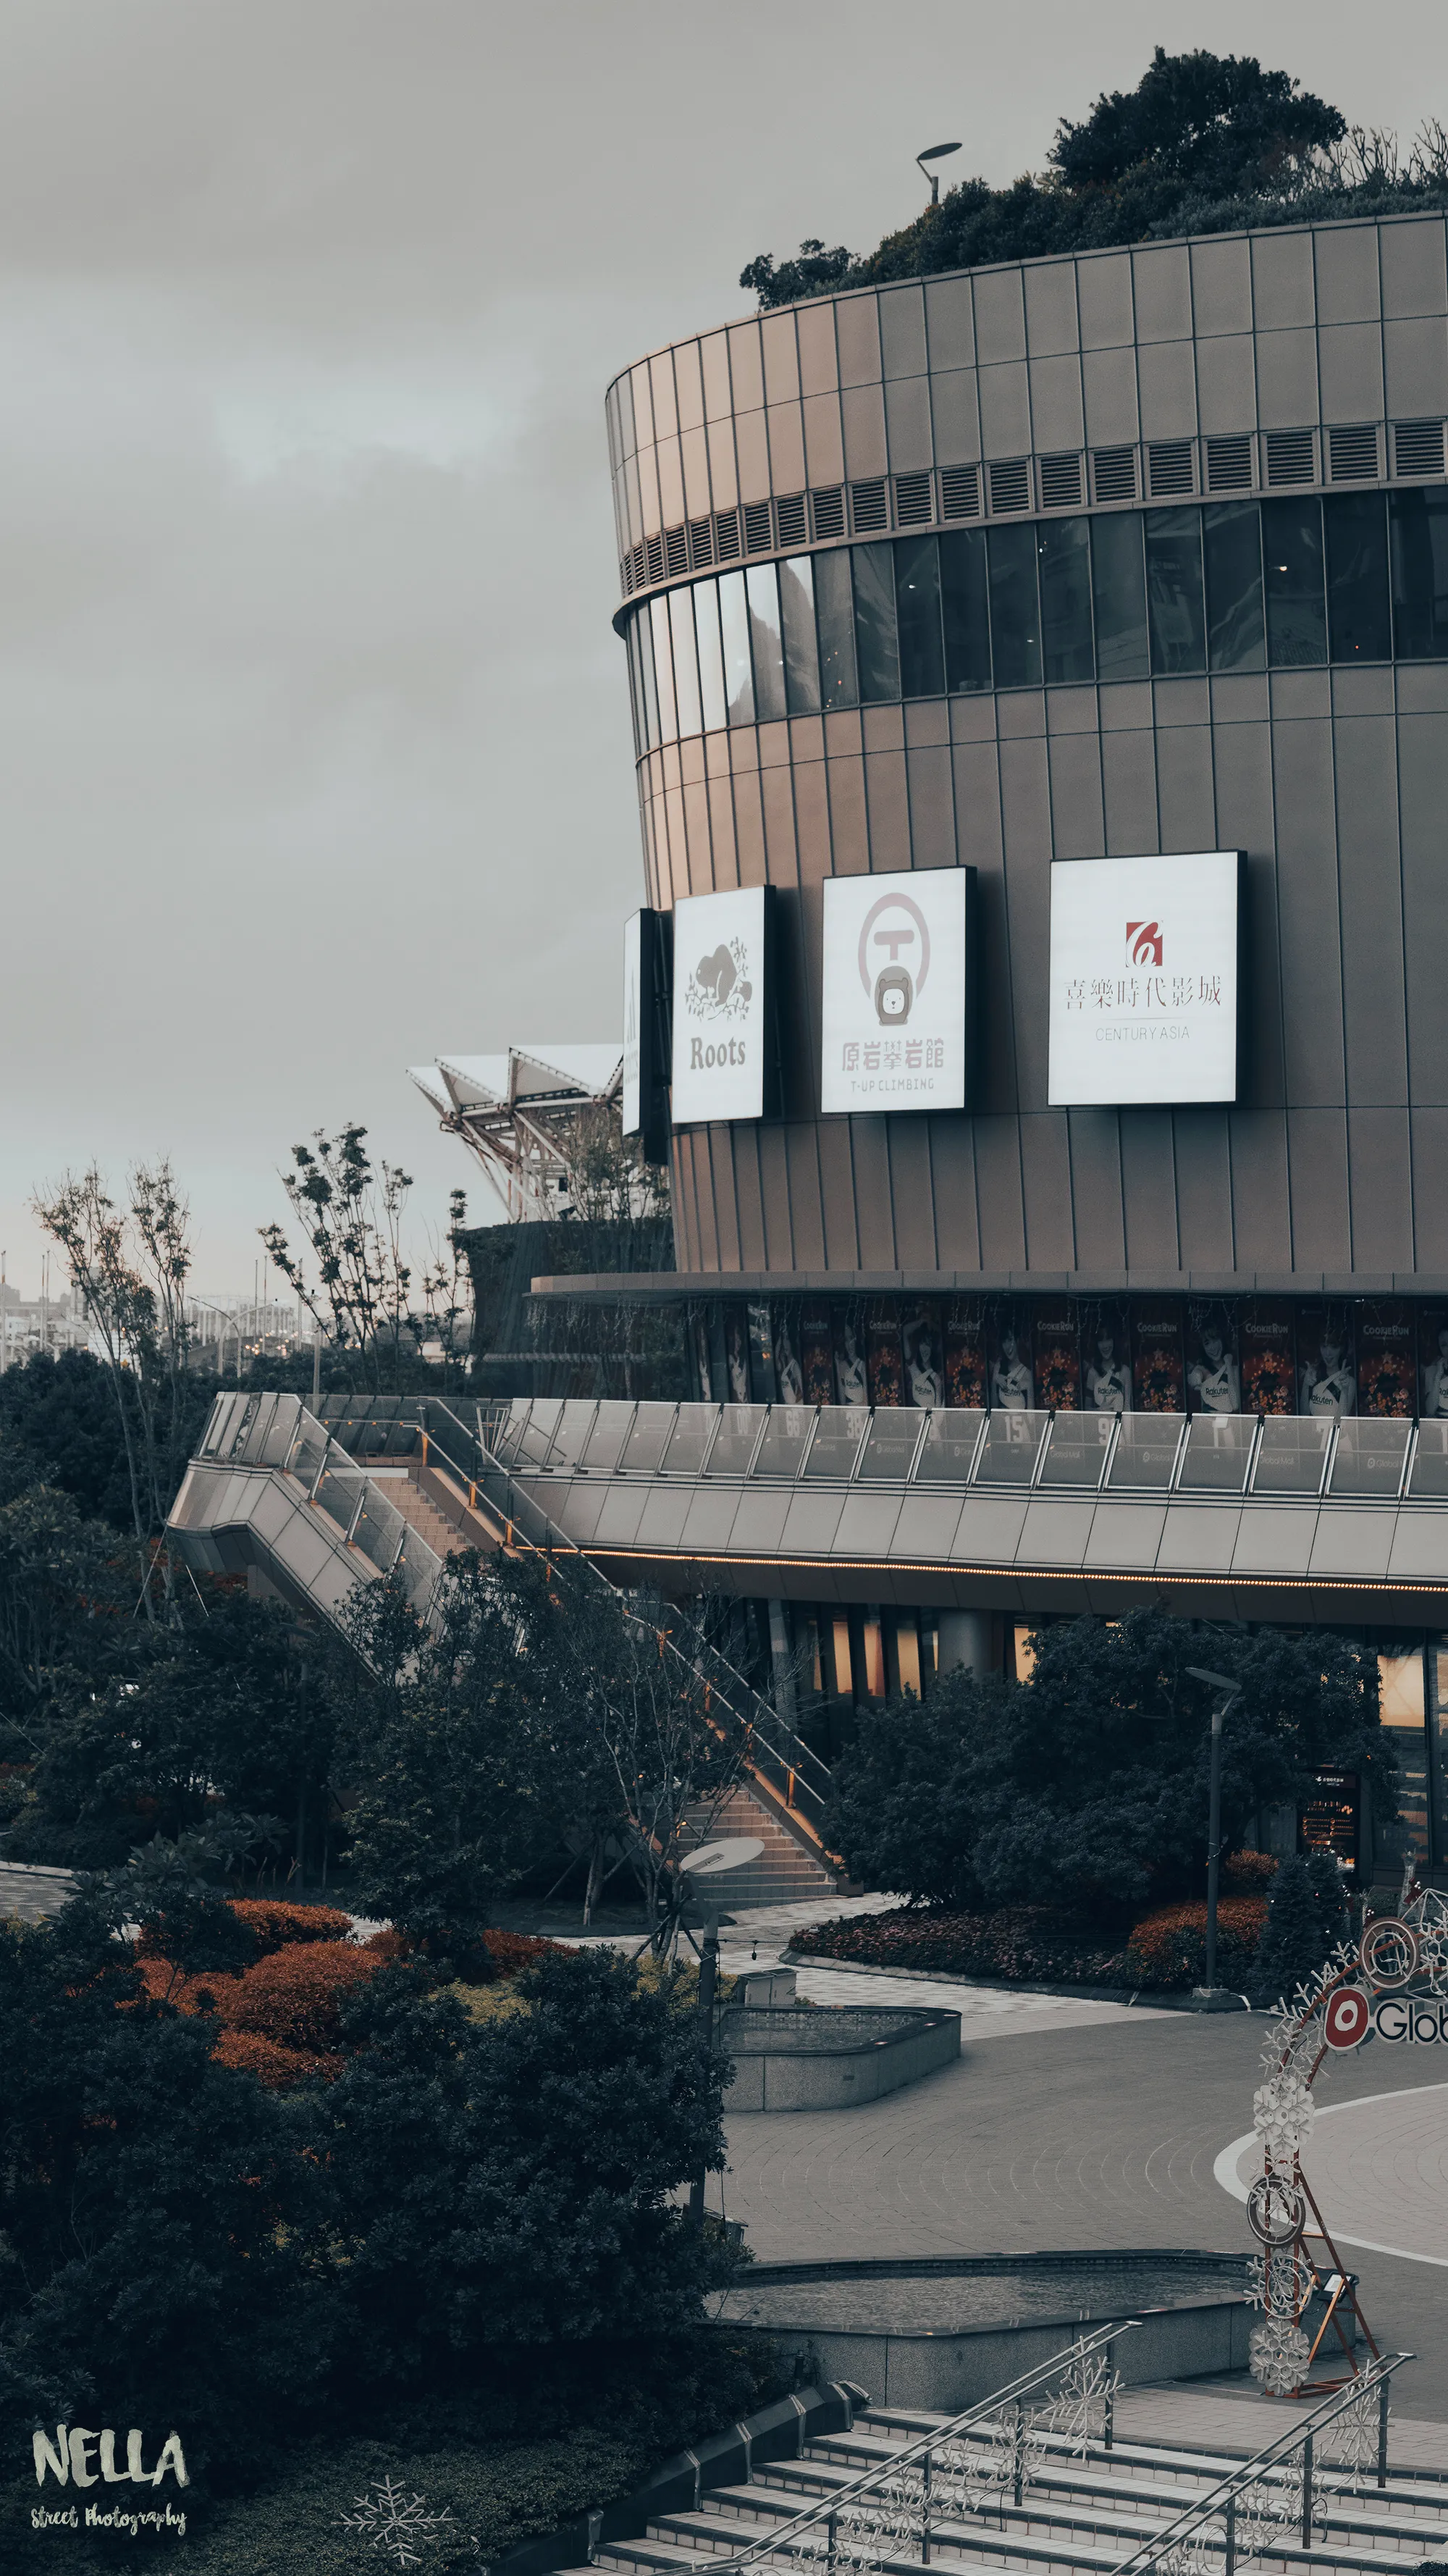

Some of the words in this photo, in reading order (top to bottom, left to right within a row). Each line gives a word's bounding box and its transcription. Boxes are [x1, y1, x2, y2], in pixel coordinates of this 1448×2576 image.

[1064, 976, 1222, 1010] 喜樂時代影城
[1095, 1027, 1157, 1041] CENTURY
[1159, 1025, 1190, 1040] ASIA
[690, 1036, 746, 1070] Roots
[842, 1038, 944, 1071] 原岩攀岩館
[878, 1078, 934, 1091] CLIMBING
[1312, 1394, 1333, 1406] akuten
[1005, 1416, 1023, 1443] 15
